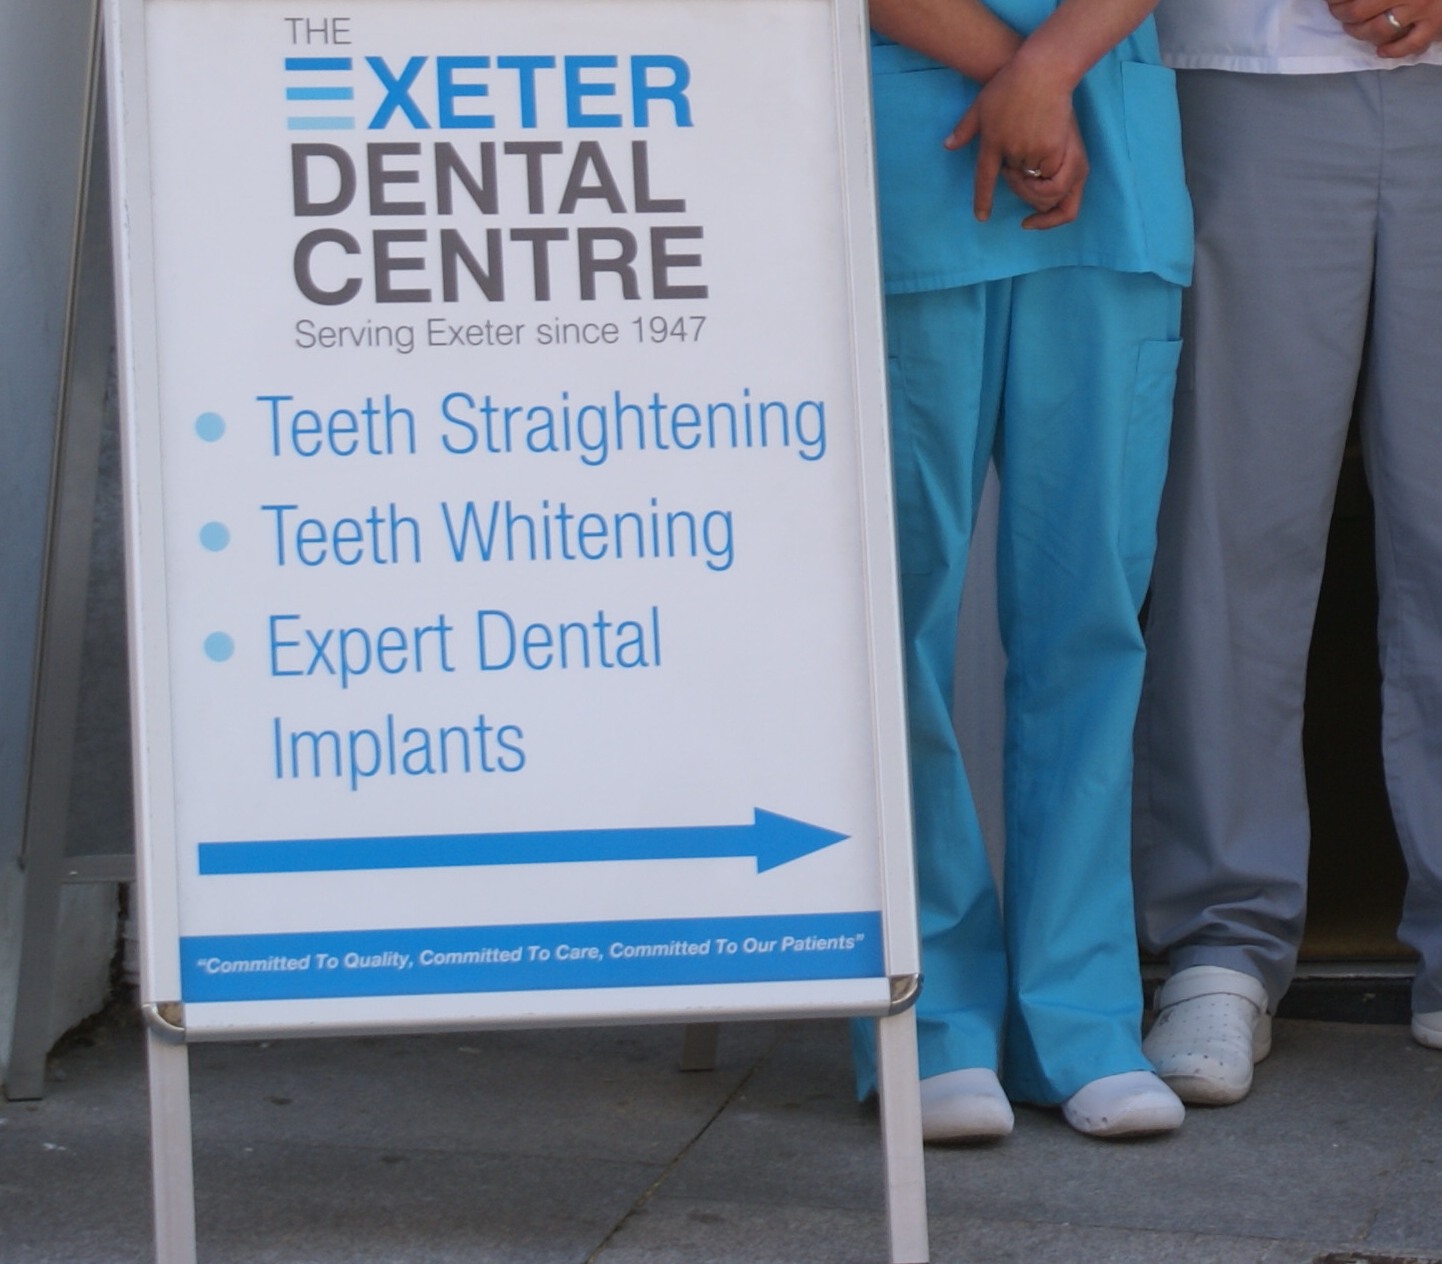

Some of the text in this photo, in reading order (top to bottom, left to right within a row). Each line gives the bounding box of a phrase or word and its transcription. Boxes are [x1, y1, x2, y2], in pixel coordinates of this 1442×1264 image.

[284, 17, 352, 45] THE
[284, 54, 694, 130] EXETER
[291, 140, 686, 217] DENTAL
[293, 226, 709, 305] CENTRE
[294, 315, 707, 354] Serving Exeter since 1947
[256, 388, 828, 466] Teeth Straightening
[260, 498, 735, 572] Teeth Whitening
[269, 606, 662, 689] Expert Dental
[273, 713, 526, 791] Implants
[316, 953, 339, 969] To
[344, 950, 414, 970] Quality,
[419, 947, 523, 965] Committed
[528, 945, 550, 961] To
[555, 944, 604, 962] Care,
[610, 940, 710, 958] Committed
[716, 938, 738, 955] To
[743, 937, 777, 953] Our
